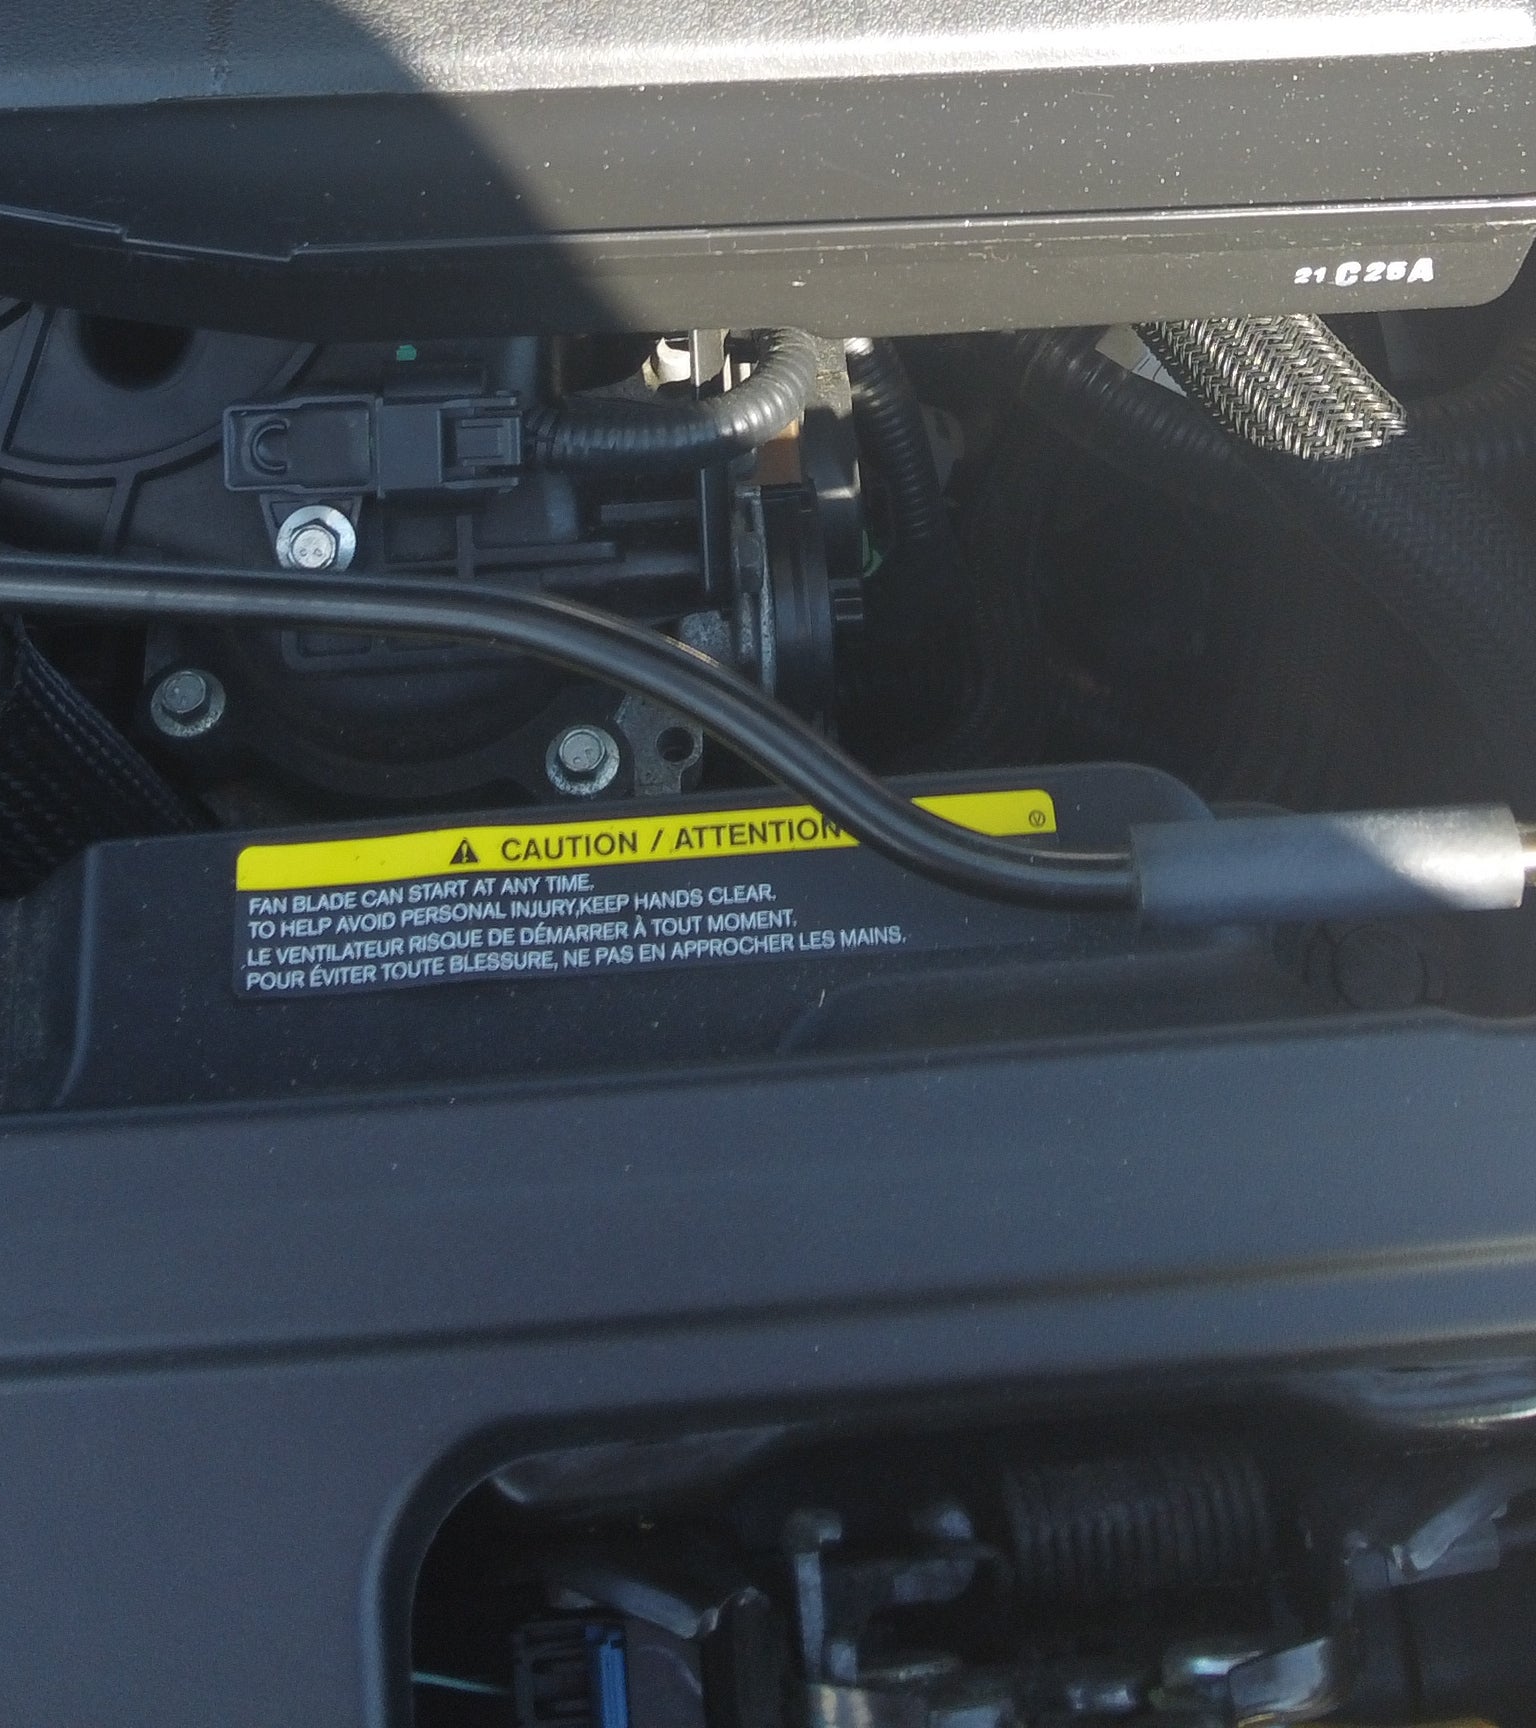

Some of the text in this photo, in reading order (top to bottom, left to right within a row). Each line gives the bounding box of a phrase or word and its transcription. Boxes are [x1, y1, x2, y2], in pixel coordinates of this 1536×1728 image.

[500, 833, 639, 862] CAUTION
[674, 815, 841, 852] ATTENTION
[247, 920, 276, 940] TO
[280, 916, 332, 938] HELP
[336, 912, 396, 934] AVOID
[401, 902, 506, 927] PERSONAL
[634, 889, 703, 911] HANDS
[709, 883, 776, 905] CLEAR.
[249, 873, 595, 916] FAN BLADE CAN START AT ANY TIME.
[246, 925, 906, 991] POUR ÉVITER TOUTE BLESSURE, NE PAS EN APPROCHER LES MAINS.
[247, 908, 797, 967] LE VENTILATEUR RISQUE DE DÉMARRER À TOUT MOMENT.
